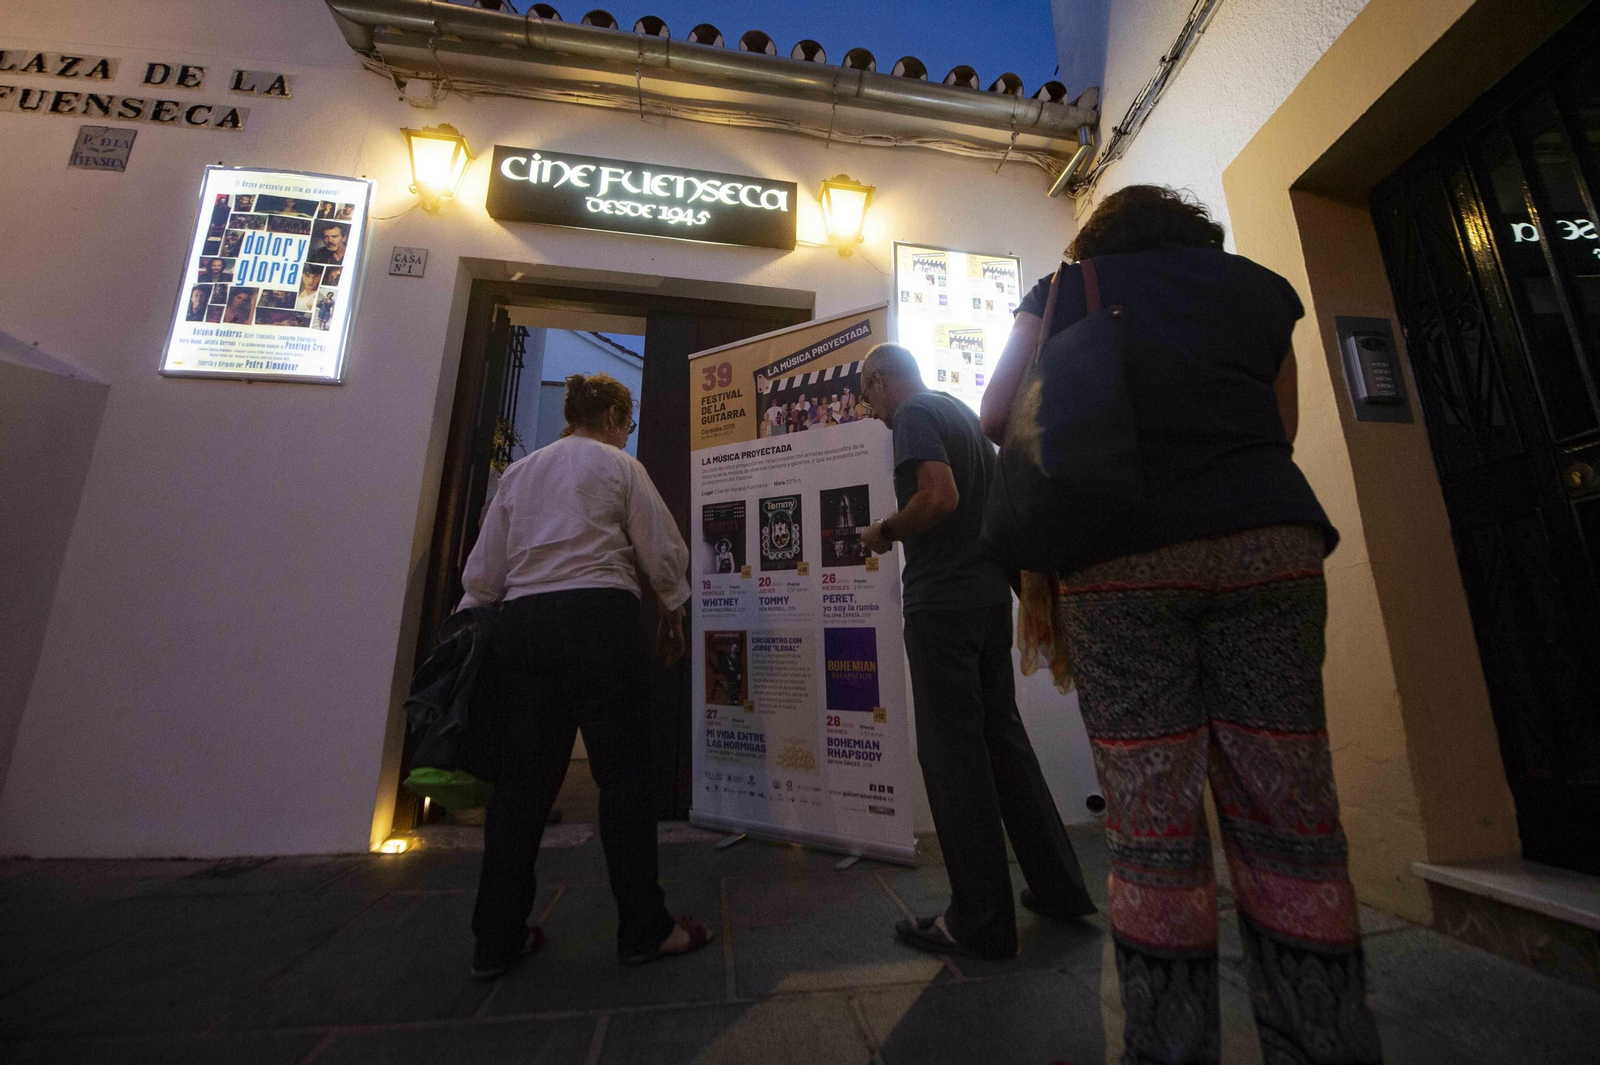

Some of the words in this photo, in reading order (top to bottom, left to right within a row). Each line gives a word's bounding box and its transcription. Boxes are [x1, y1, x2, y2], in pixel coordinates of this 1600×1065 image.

[143, 63, 205, 88] DE
[231, 70, 292, 98] LA
[242, 180, 258, 188] Deseo
[259, 183, 283, 191] presenta
[658, 205, 711, 226] 1945
[243, 231, 293, 257] dolor
[294, 239, 307, 263] y
[394, 253, 422, 265] CASA
[235, 255, 299, 286] gloria
[407, 264, 412, 274] 1
[215, 328, 243, 338] Banderas
[767, 366, 779, 377] LA
[779, 351, 811, 371] MÚSICA
[811, 325, 869, 358] PROYECTADA
[244, 359, 264, 369] Pedro
[701, 361, 733, 392] 39
[701, 388, 743, 406] FESTIVAL
[701, 404, 713, 416] DE
[714, 402, 726, 413] LA
[701, 408, 746, 425] GUITARRA
[701, 458, 711, 466] LA
[712, 453, 740, 464] MÚSICA
[741, 444, 792, 459] PROYECTADA
[736, 460, 764, 469] proyecciones
[804, 450, 823, 458] artistas
[824, 446, 852, 455] destacados
[728, 469, 743, 477] música
[750, 465, 767, 473] diversos
[768, 463, 787, 471] tiempos
[832, 452, 853, 461] presenta
[747, 482, 768, 490] Fuenseca
[767, 500, 795, 510] Tommy
[702, 580, 711, 589] 19
[758, 576, 771, 587] 20
[822, 573, 836, 584] 26
[702, 597, 739, 607] WHITNEY
[758, 596, 789, 605] TOMMY
[823, 593, 857, 604] PERET,
[823, 605, 832, 613] yo
[833, 605, 847, 613] soy
[848, 603, 855, 611] la
[856, 603, 879, 611] rumba
[827, 660, 877, 672] BOHEMIAN
[831, 671, 873, 680] RHAPSODY
[706, 709, 718, 719] 27
[826, 715, 841, 727] 28
[706, 728, 715, 738] MI
[716, 730, 735, 740] VIDA
[737, 731, 765, 743] ENTRE
[706, 738, 722, 749] LAS
[723, 740, 766, 753] HORMIGAS
[827, 737, 880, 751] BOHEMIAN
[827, 748, 882, 762] RHAPSODY
